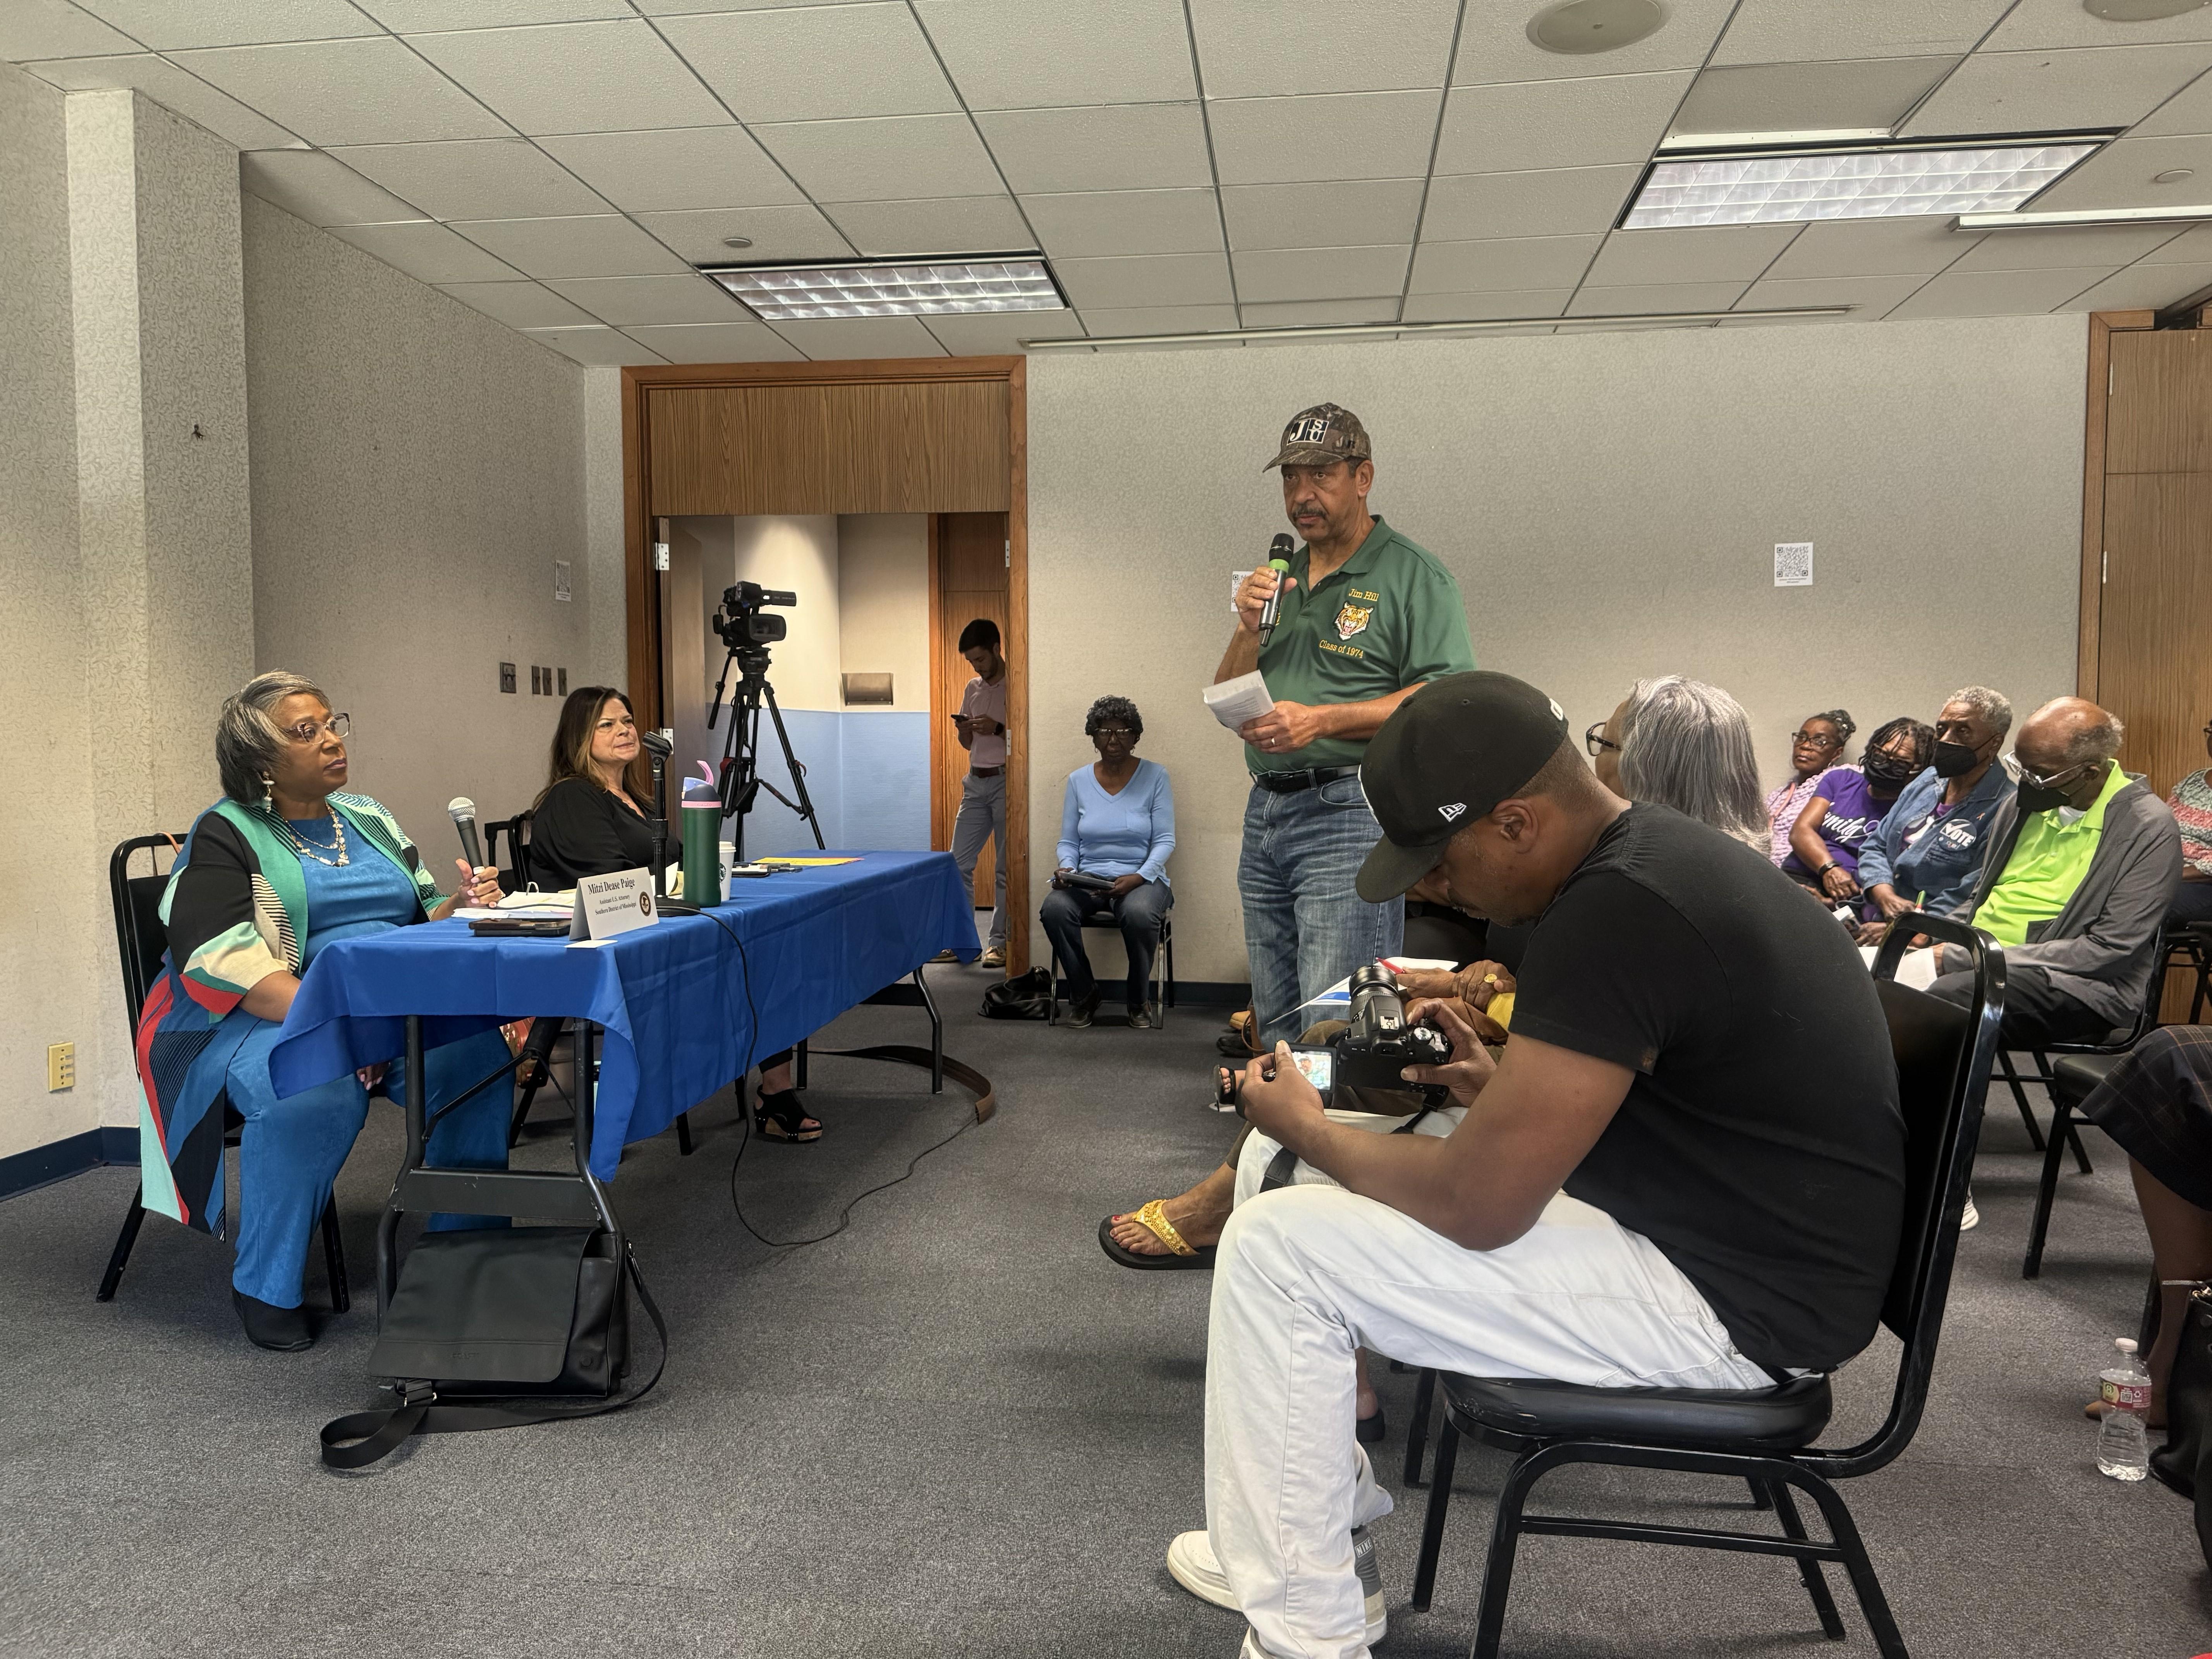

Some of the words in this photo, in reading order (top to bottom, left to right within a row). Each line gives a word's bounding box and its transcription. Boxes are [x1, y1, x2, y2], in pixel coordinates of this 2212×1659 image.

[1348, 589, 1362, 598] Jim
[1363, 591, 1379, 601] Hill
[1319, 640, 1337, 651] Class
[1338, 645, 1346, 653] of
[1347, 647, 1364, 658] 1974
[1943, 823, 1975, 847] VOTE
[588, 883, 603, 895] Mitzi
[604, 881, 620, 891] Dease
[620, 878, 635, 890] Paige
[622, 901, 637, 909] Mississippi
[1357, 1539, 1372, 1556] NIKE
